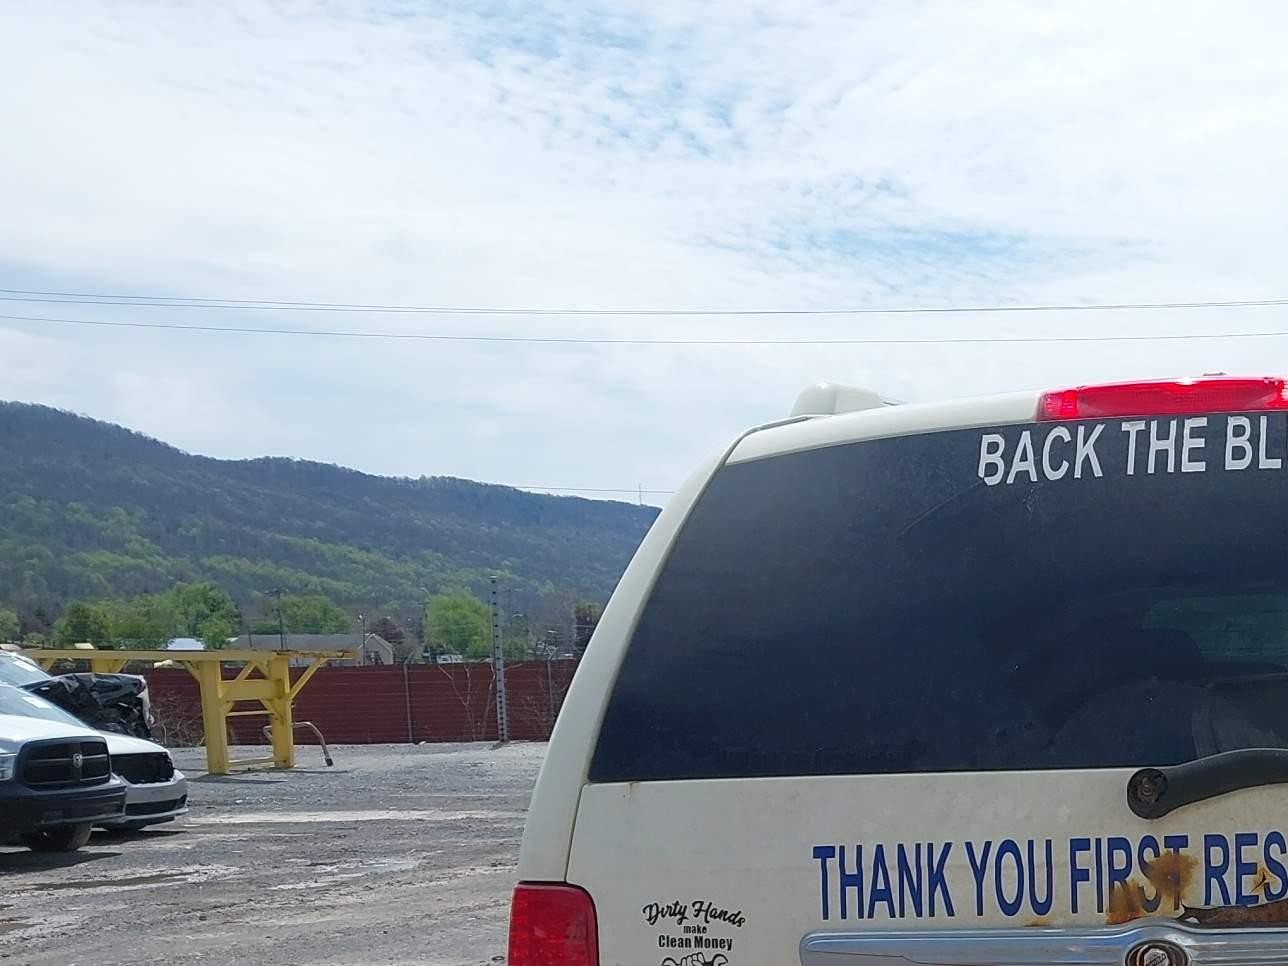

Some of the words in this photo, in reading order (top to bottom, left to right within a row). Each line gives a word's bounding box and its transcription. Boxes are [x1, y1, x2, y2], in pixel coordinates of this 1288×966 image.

[977, 422, 1106, 487] BACK
[1120, 417, 1208, 475] THE
[812, 841, 958, 921] THANK
[965, 838, 1054, 917] YOU
[1068, 834, 1189, 914] FIRST
[642, 900, 690, 925] Dirty
[691, 900, 746, 927] Hands
[658, 935, 692, 948] Clean
[694, 936, 733, 951] Money
[683, 925, 707, 934] make
